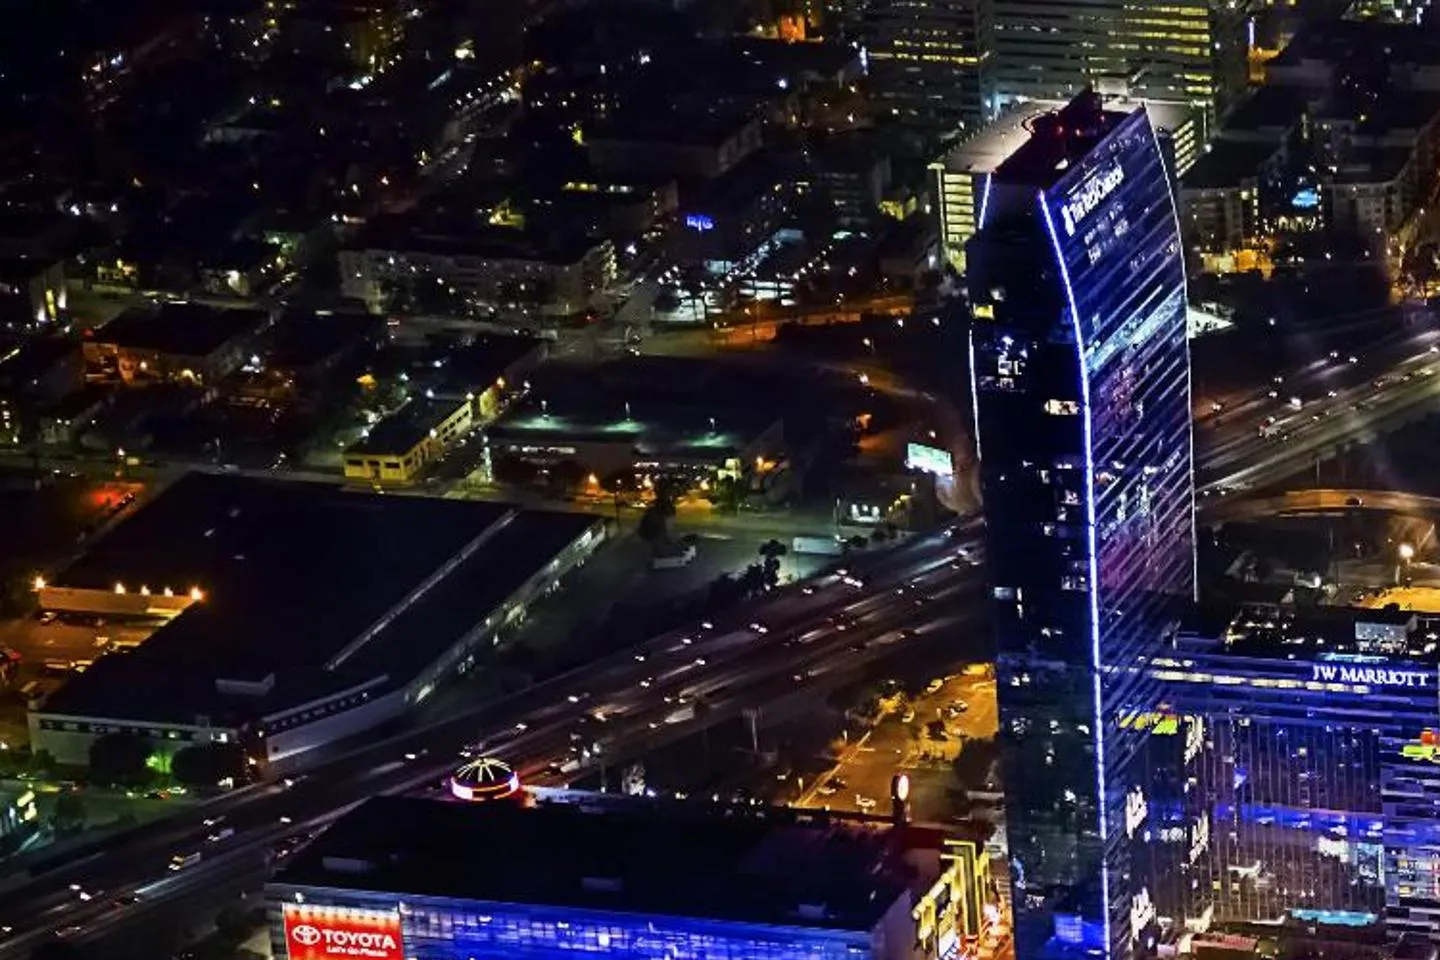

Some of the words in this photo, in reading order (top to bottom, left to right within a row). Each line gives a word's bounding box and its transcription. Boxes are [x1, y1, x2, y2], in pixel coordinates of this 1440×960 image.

[1313, 665, 1336, 680] JW
[1340, 666, 1428, 686] MARRIOTT
[322, 929, 396, 949] TOYOTA
